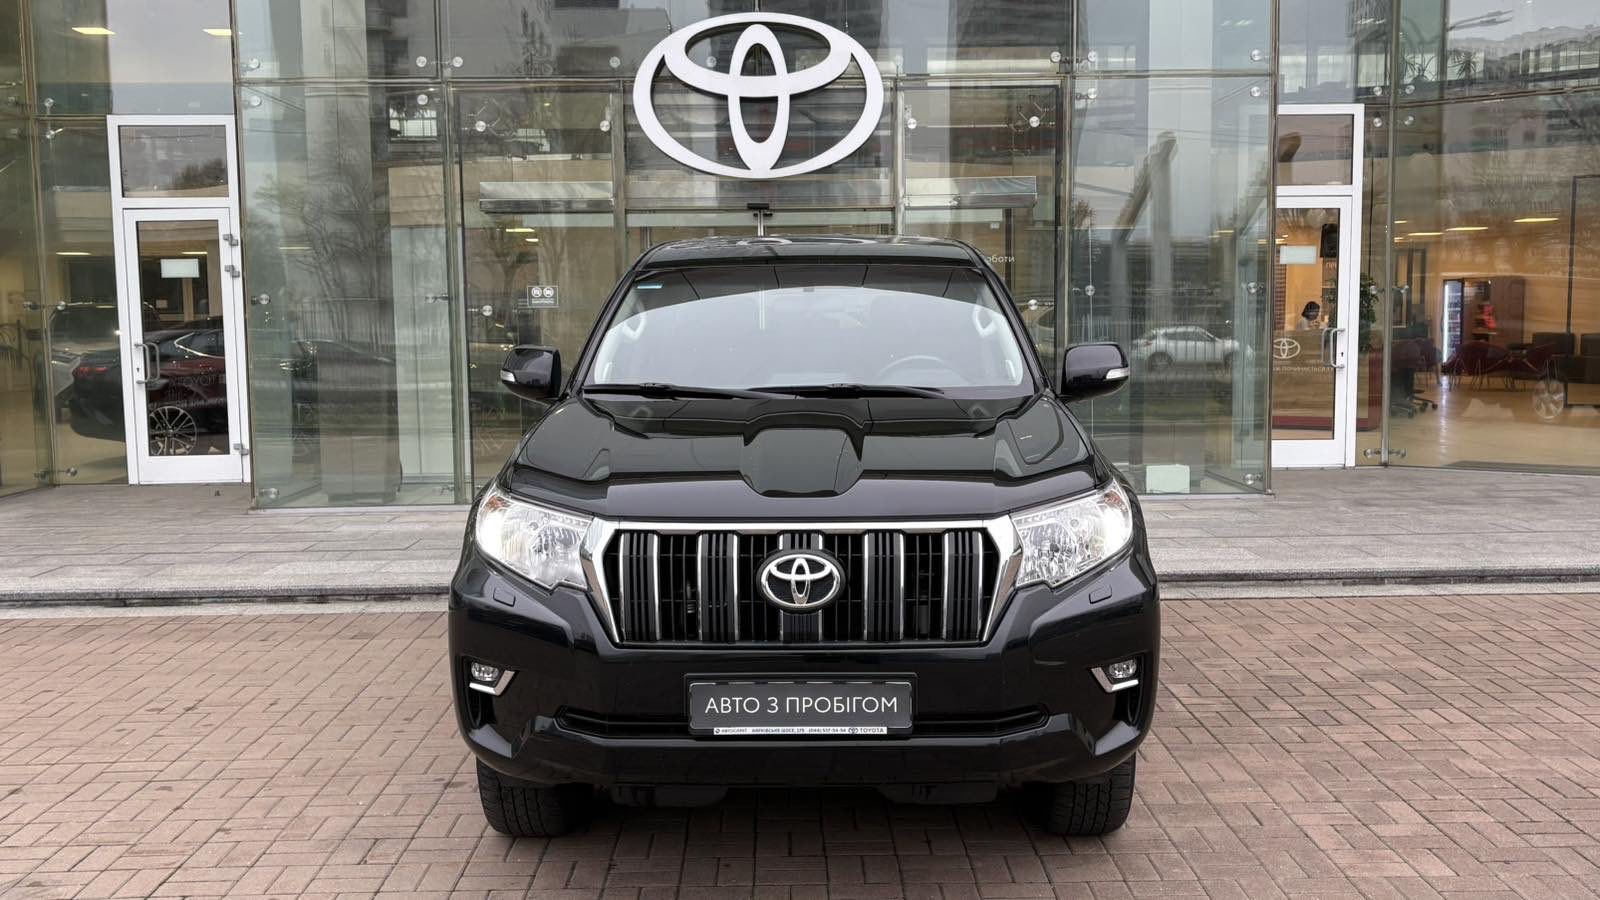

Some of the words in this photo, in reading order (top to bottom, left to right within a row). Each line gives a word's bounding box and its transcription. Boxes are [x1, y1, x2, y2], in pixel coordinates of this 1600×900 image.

[986, 254, 1015, 263] оботи
[704, 696, 760, 714] АВТО
[786, 696, 898, 713] ПРОБІГОМ
